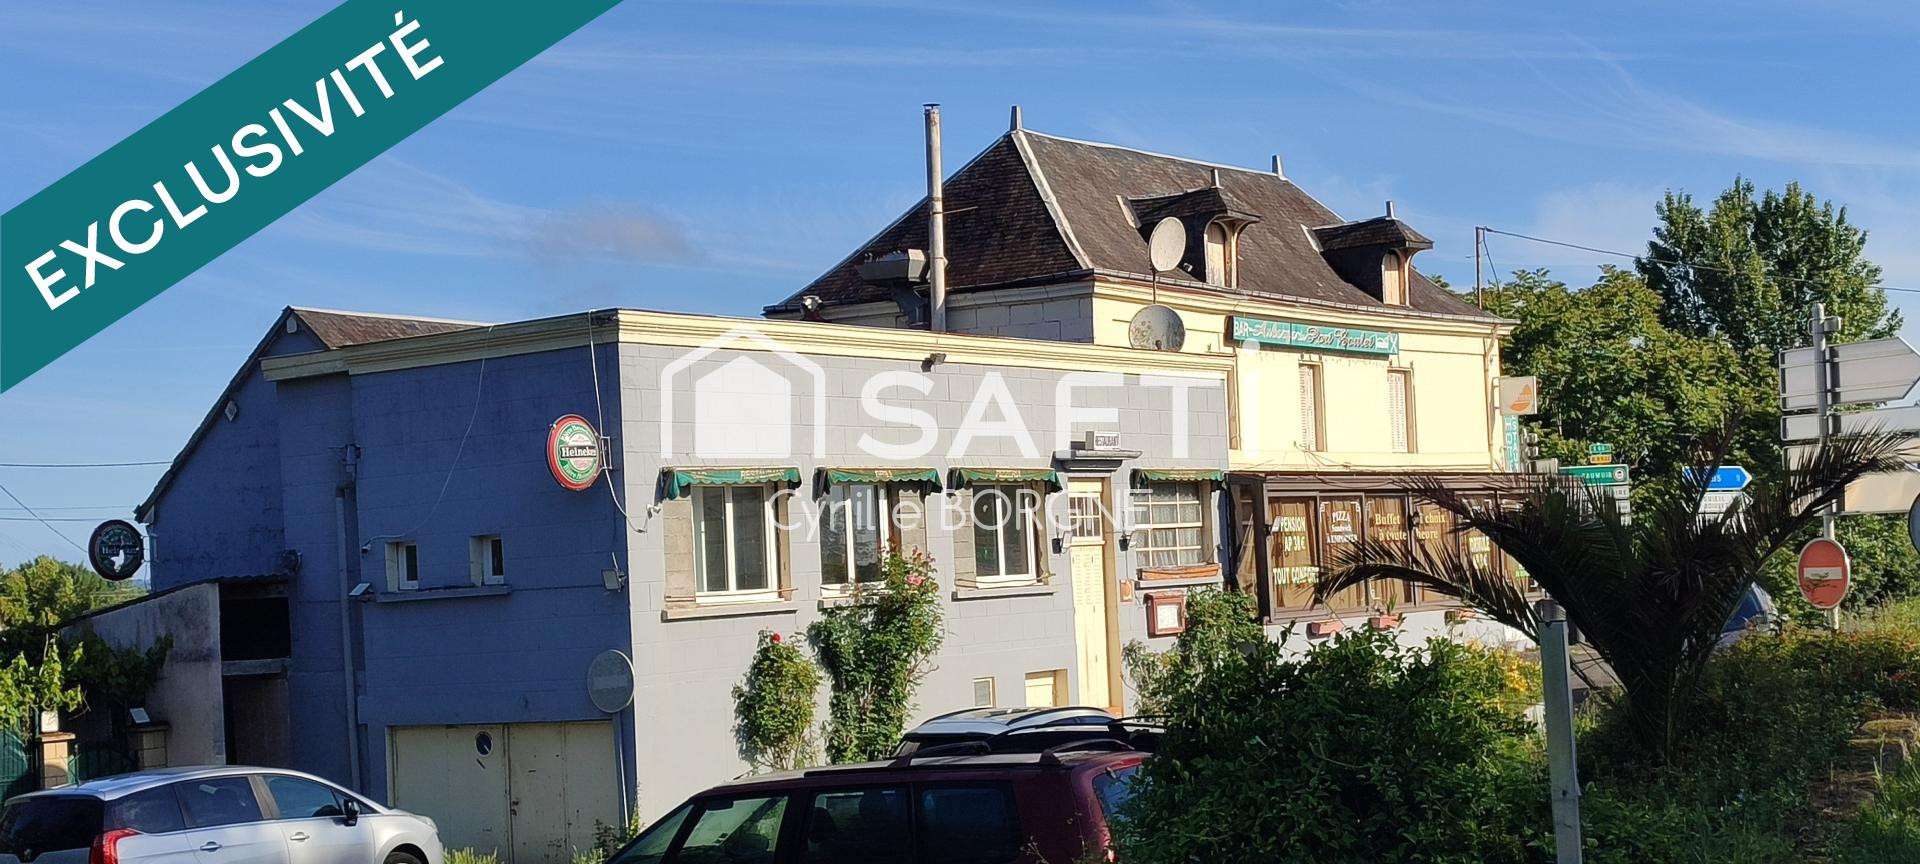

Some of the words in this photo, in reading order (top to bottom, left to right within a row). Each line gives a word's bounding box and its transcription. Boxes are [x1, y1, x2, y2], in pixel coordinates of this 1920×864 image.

[1280, 516, 1306, 532] PENSION
[1331, 511, 1352, 523] PIZZA
[1375, 513, 1401, 525] Buffet
[1273, 567, 1290, 585] TOUT
